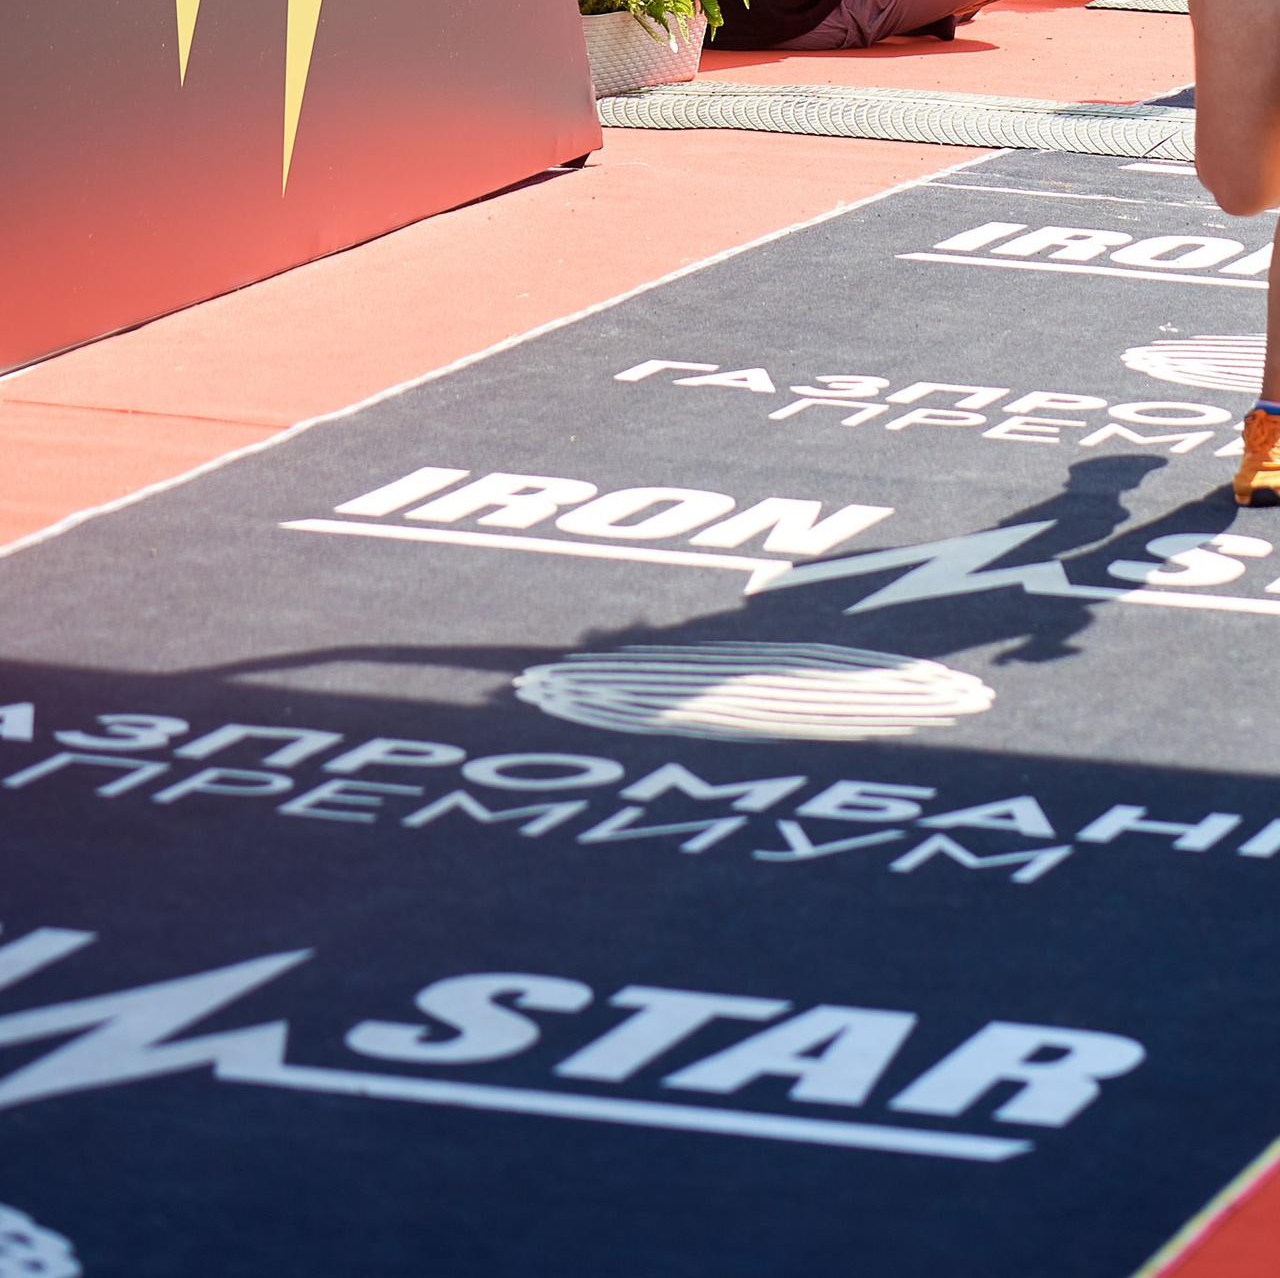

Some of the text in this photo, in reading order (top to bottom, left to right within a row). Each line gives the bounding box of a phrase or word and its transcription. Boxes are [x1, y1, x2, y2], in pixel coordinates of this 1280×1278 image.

[333, 466, 895, 556] IRON
[3, 752, 1074, 884] ПРЕМИУМ
[345, 972, 1147, 1128] STAR
